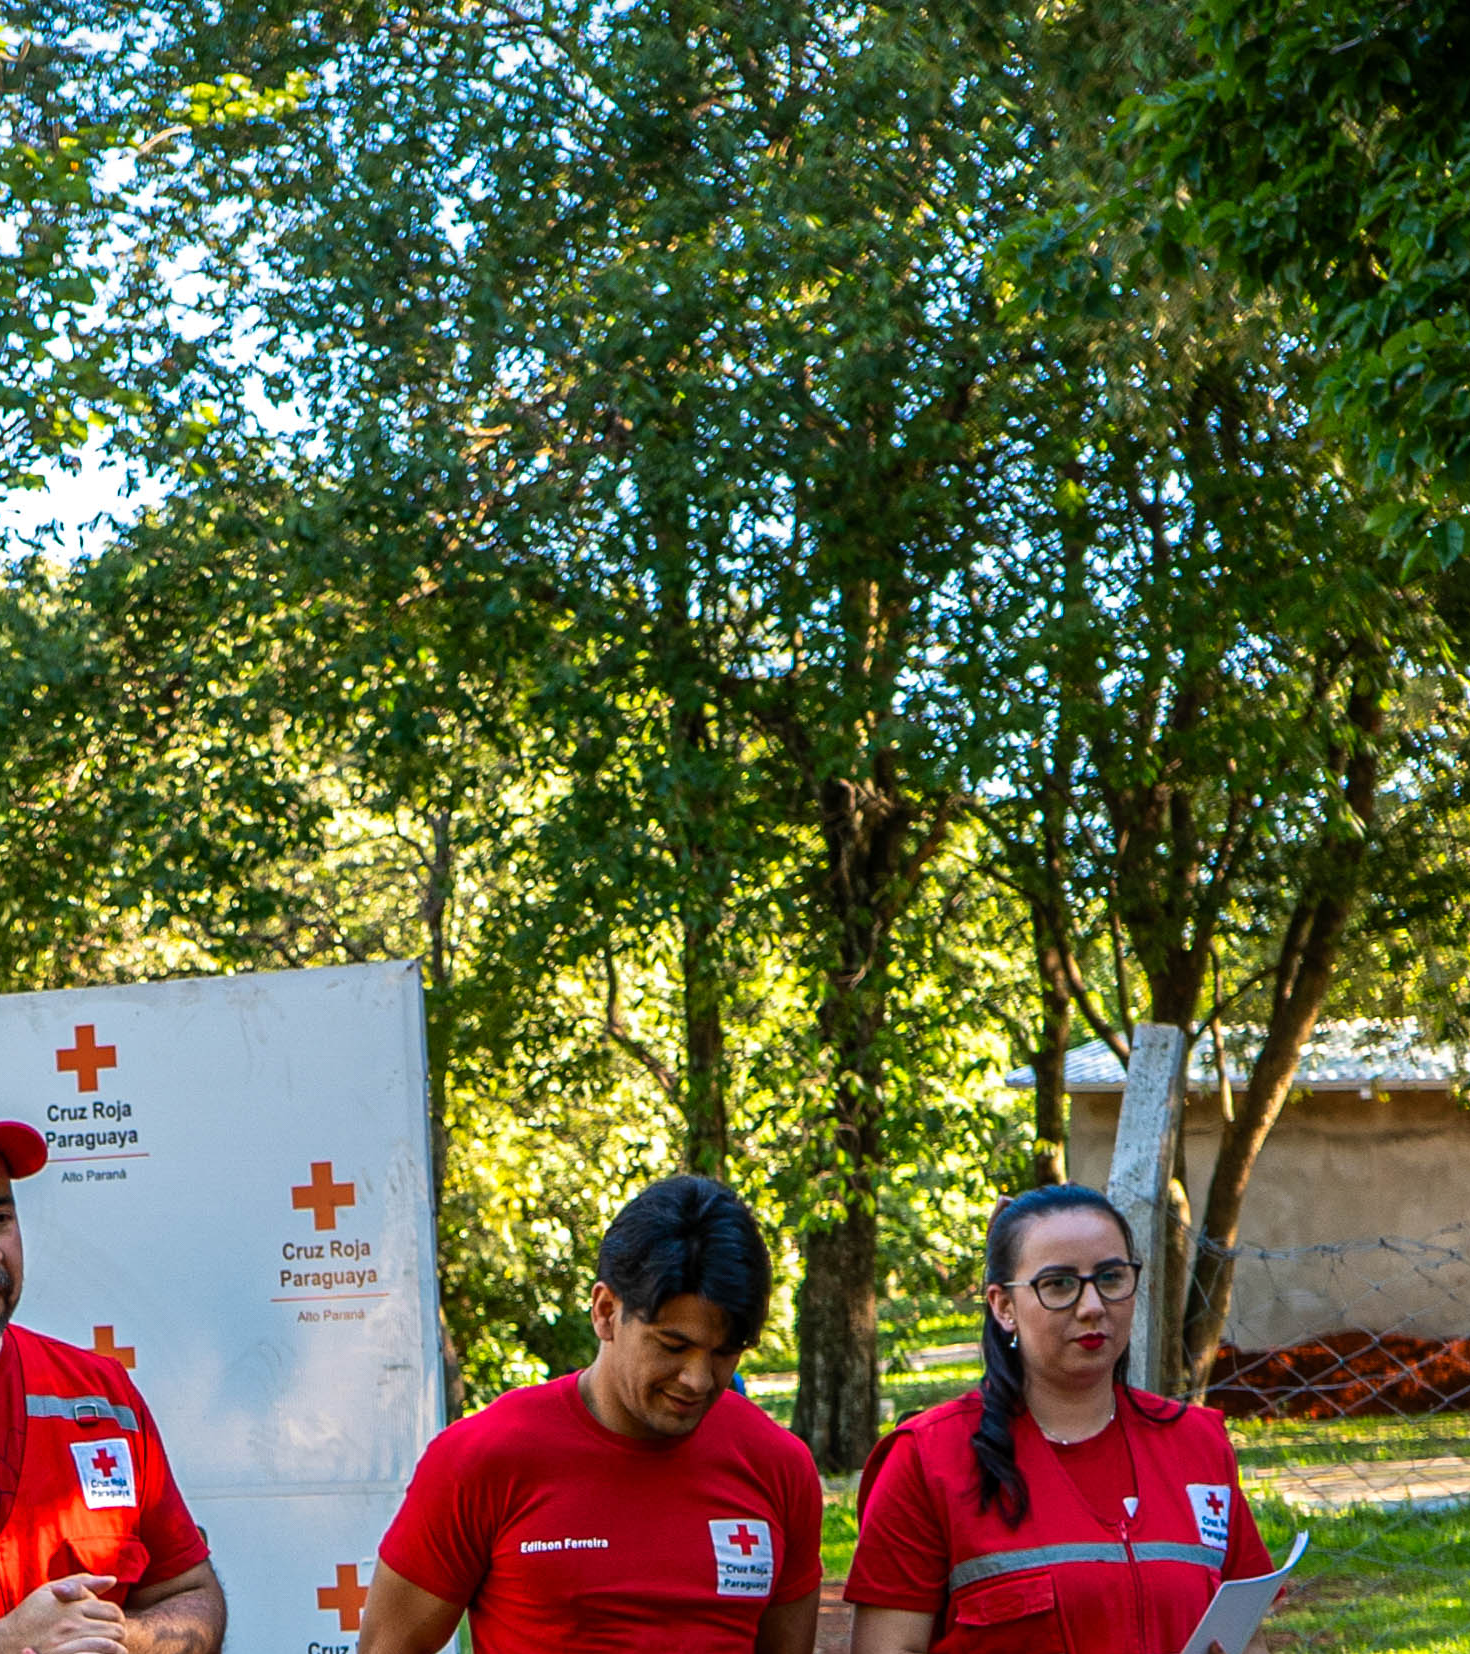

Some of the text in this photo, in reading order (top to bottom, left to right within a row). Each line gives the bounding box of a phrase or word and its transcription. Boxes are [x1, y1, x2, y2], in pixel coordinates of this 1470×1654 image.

[47, 1100, 132, 1122] Cruz Roja
[45, 1129, 138, 1150] Paraguaya
[61, 1168, 126, 1183] Alto Paraná
[282, 1239, 370, 1261] Cruz Roja
[280, 1269, 378, 1289] Paraguaya
[298, 1311, 320, 1322] Alto
[521, 1537, 608, 1553] Edilson Ferreira
